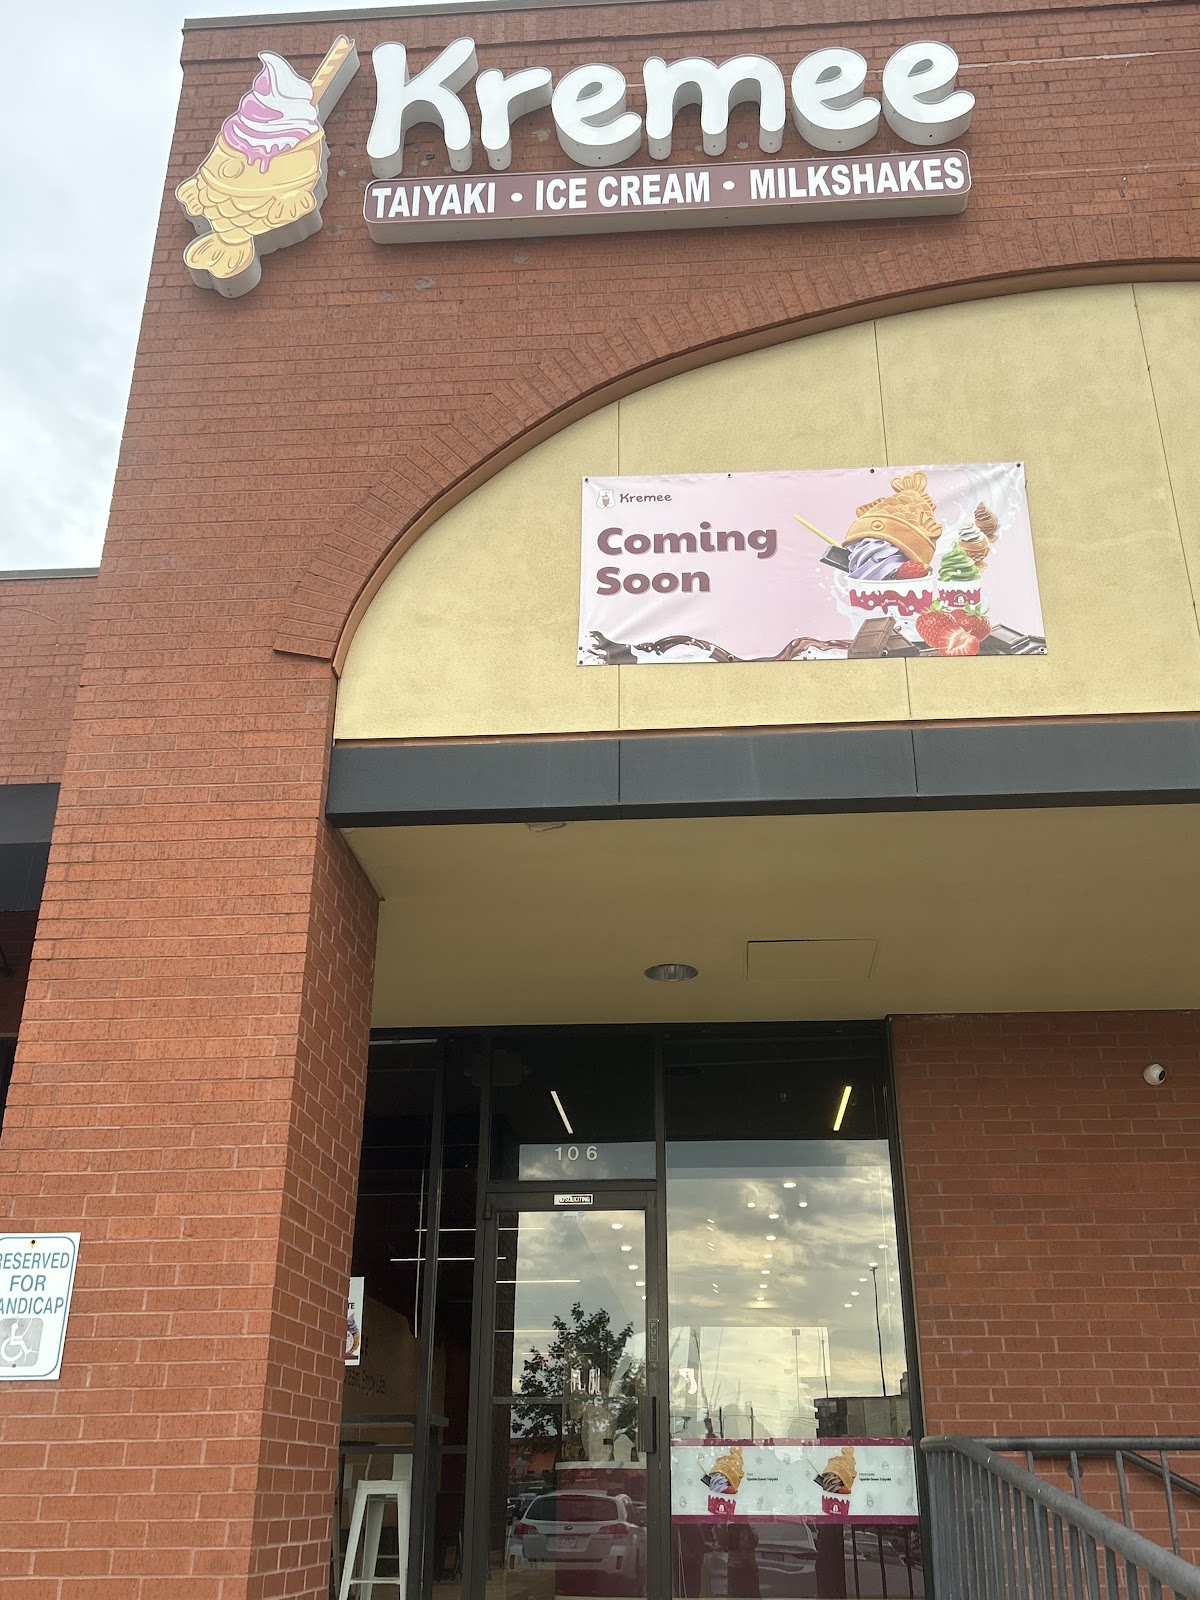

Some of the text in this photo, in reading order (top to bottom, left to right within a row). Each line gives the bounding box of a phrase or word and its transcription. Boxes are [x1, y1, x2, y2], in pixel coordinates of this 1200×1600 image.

[366, 37, 977, 170] Kremee
[372, 157, 966, 218] TAIYAKI ICE CREAM MILKSHAKES
[620, 493, 672, 503] Kremee
[597, 521, 779, 559] Coming
[596, 566, 711, 596] Soon
[0, 1252, 70, 1269] ESERVED
[9, 1274, 47, 1292] FOR
